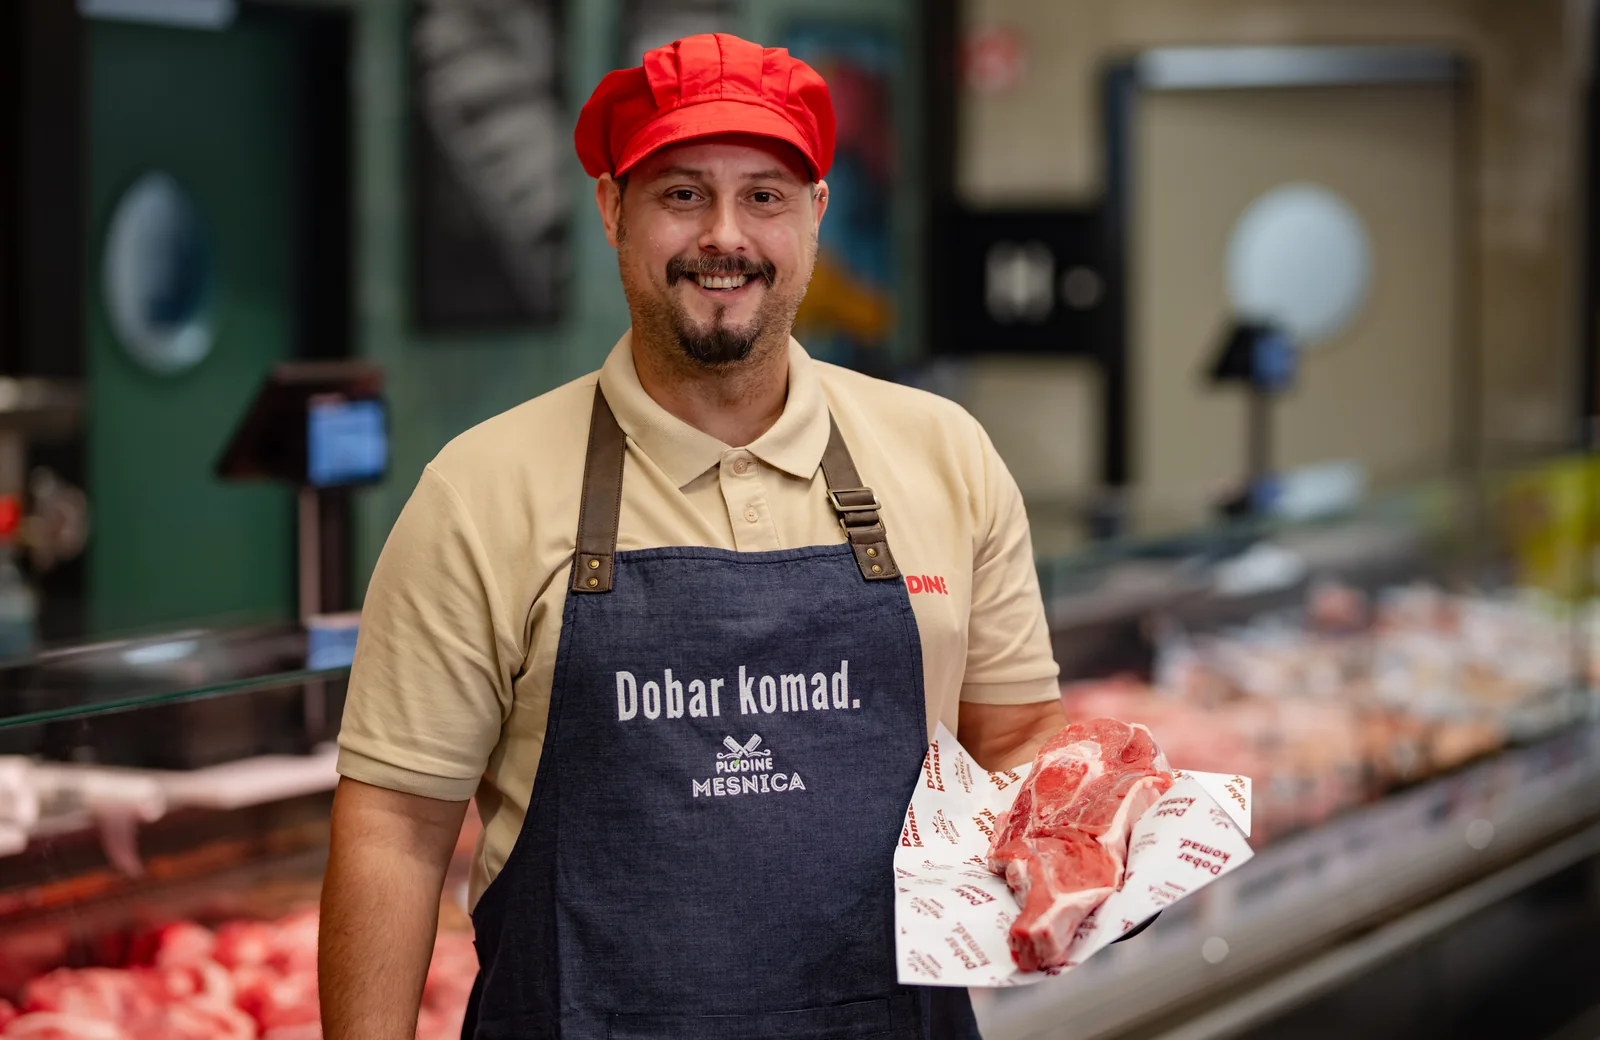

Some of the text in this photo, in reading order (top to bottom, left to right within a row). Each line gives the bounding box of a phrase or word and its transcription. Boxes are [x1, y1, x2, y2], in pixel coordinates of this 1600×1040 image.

[905, 574, 949, 596] DINE
[615, 660, 861, 722] Dobar komad.
[715, 757, 774, 774] PLODINE
[923, 751, 936, 790] Doba
[934, 739, 946, 793] komad.
[692, 772, 806, 798] MESNICA
[1177, 852, 1222, 876] Dobar
[1179, 837, 1233, 864] komad.
[944, 936, 978, 971] Dobar
